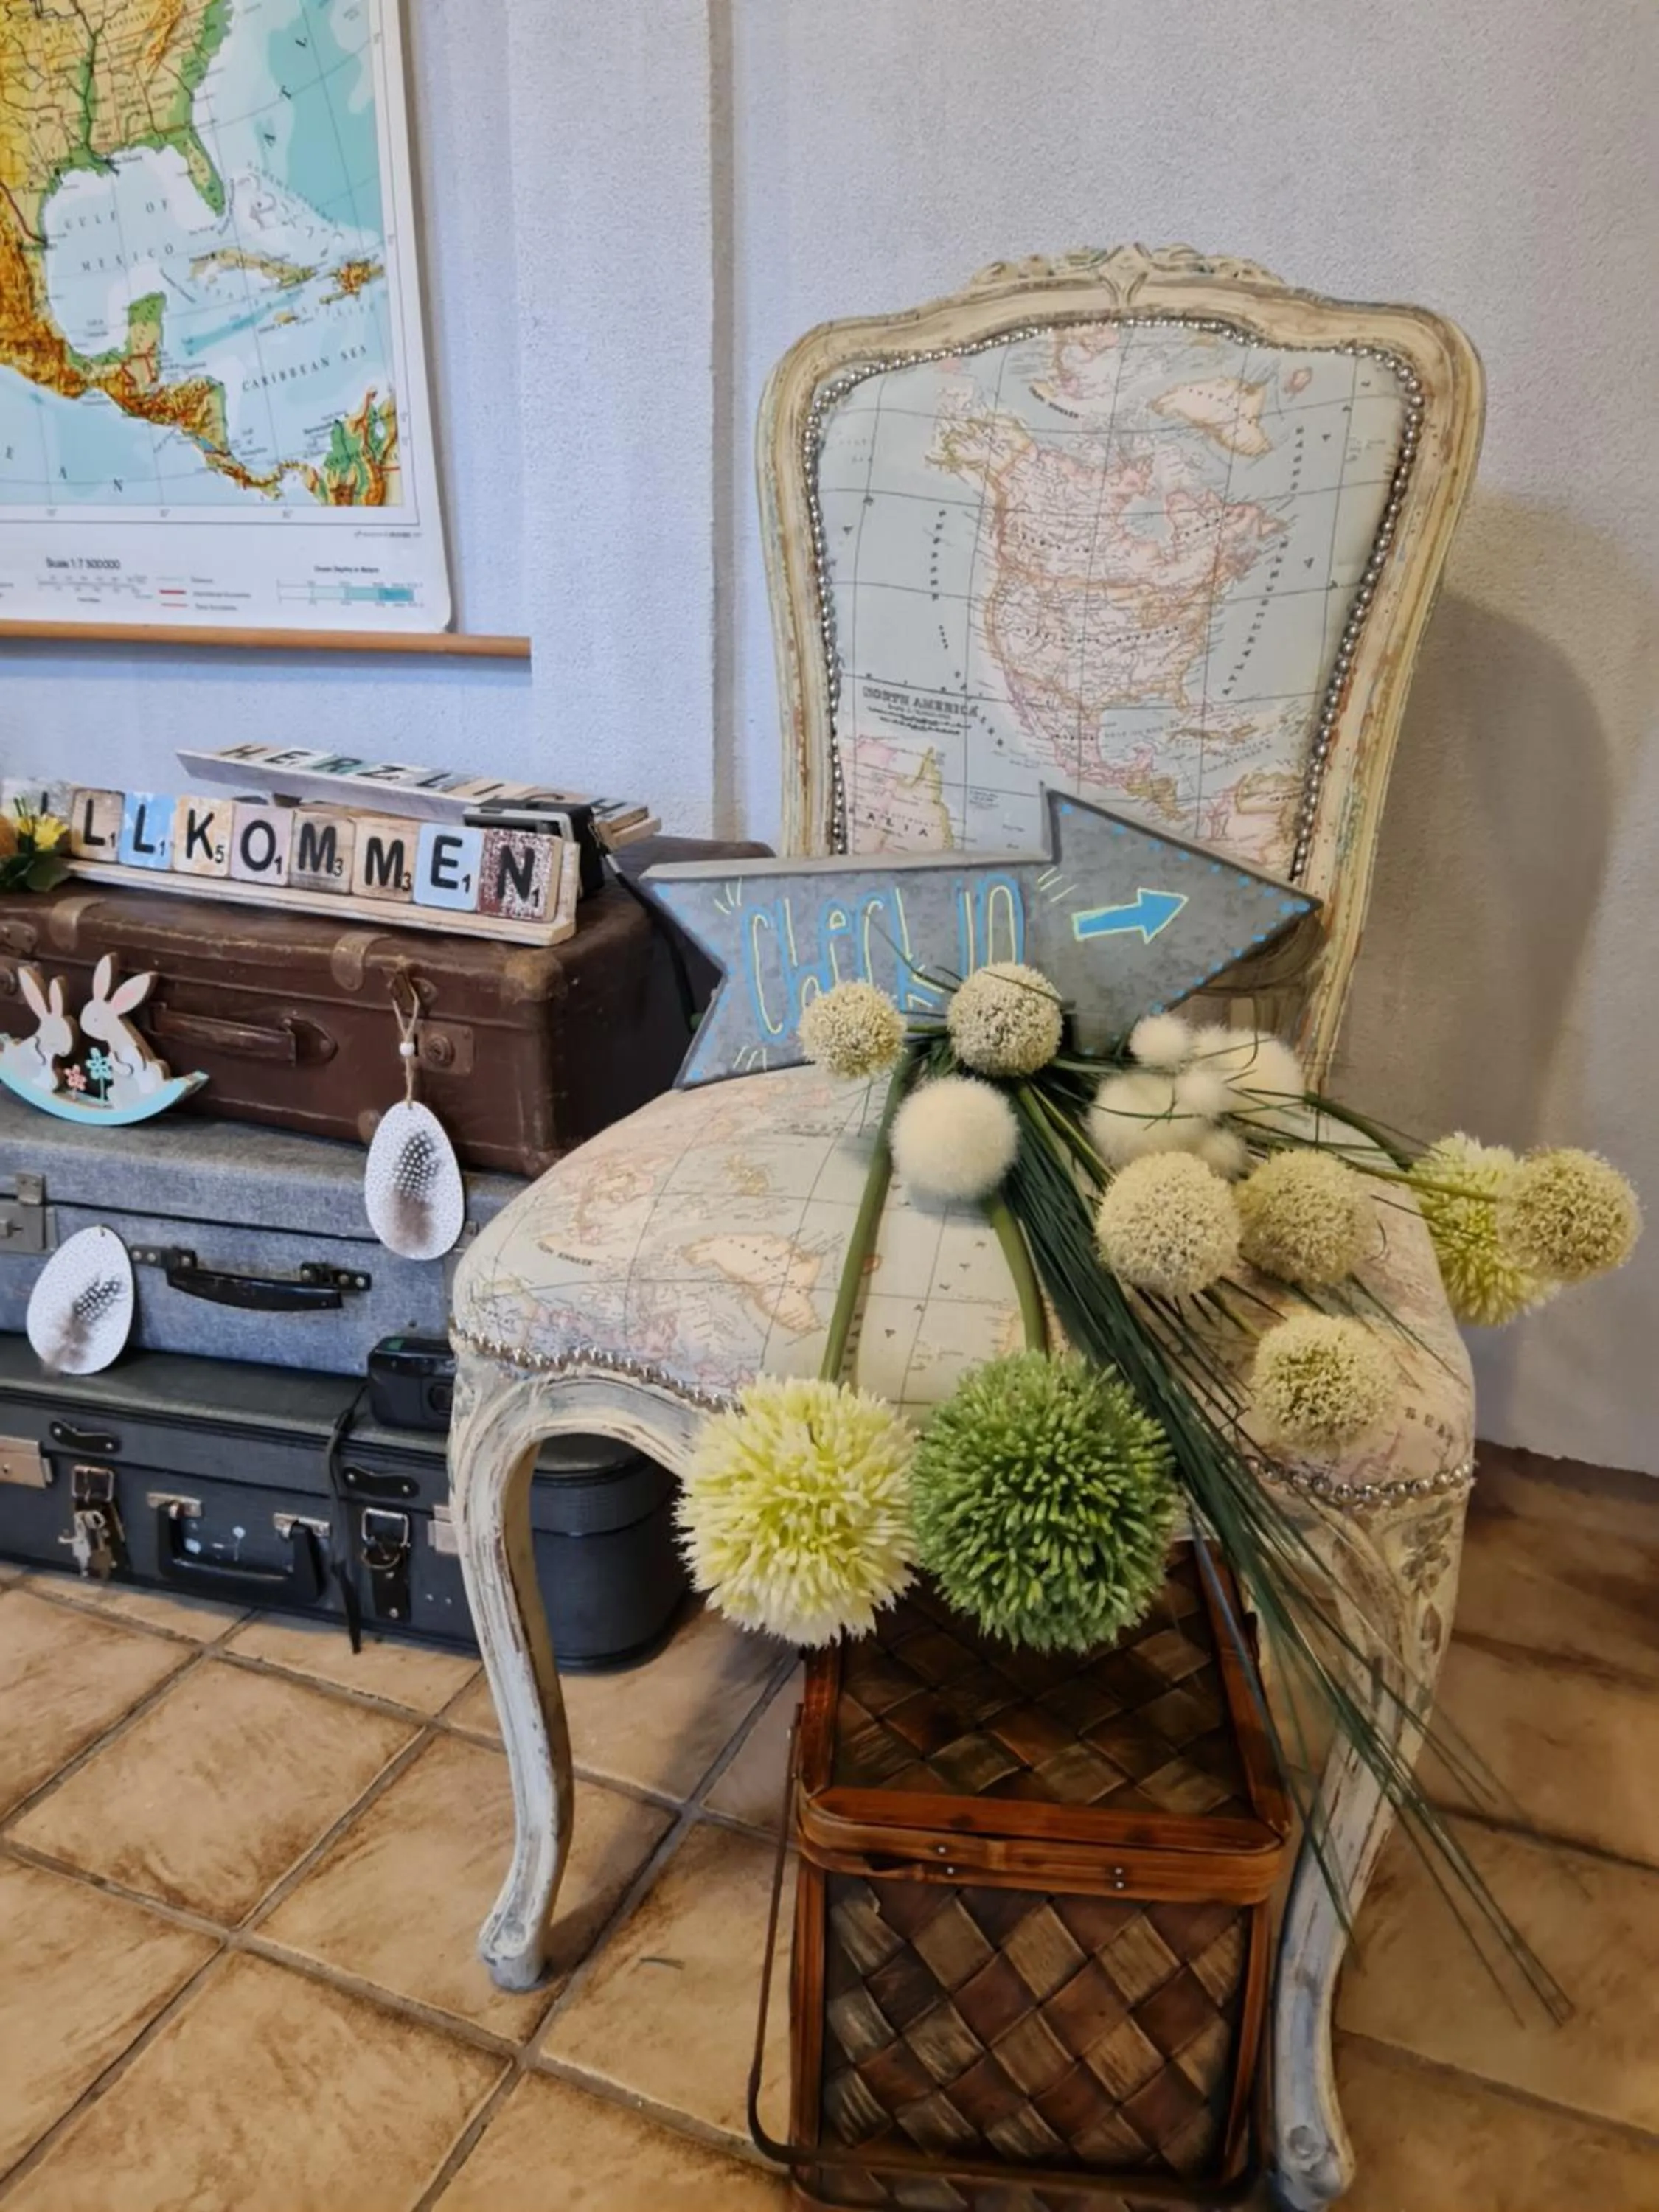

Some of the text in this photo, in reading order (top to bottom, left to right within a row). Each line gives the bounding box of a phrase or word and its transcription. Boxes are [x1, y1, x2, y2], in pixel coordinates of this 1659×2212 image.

[82, 243, 175, 272] MEXICO
[242, 356, 330, 392] CARIBBEAN
[340, 344, 367, 360] SEA
